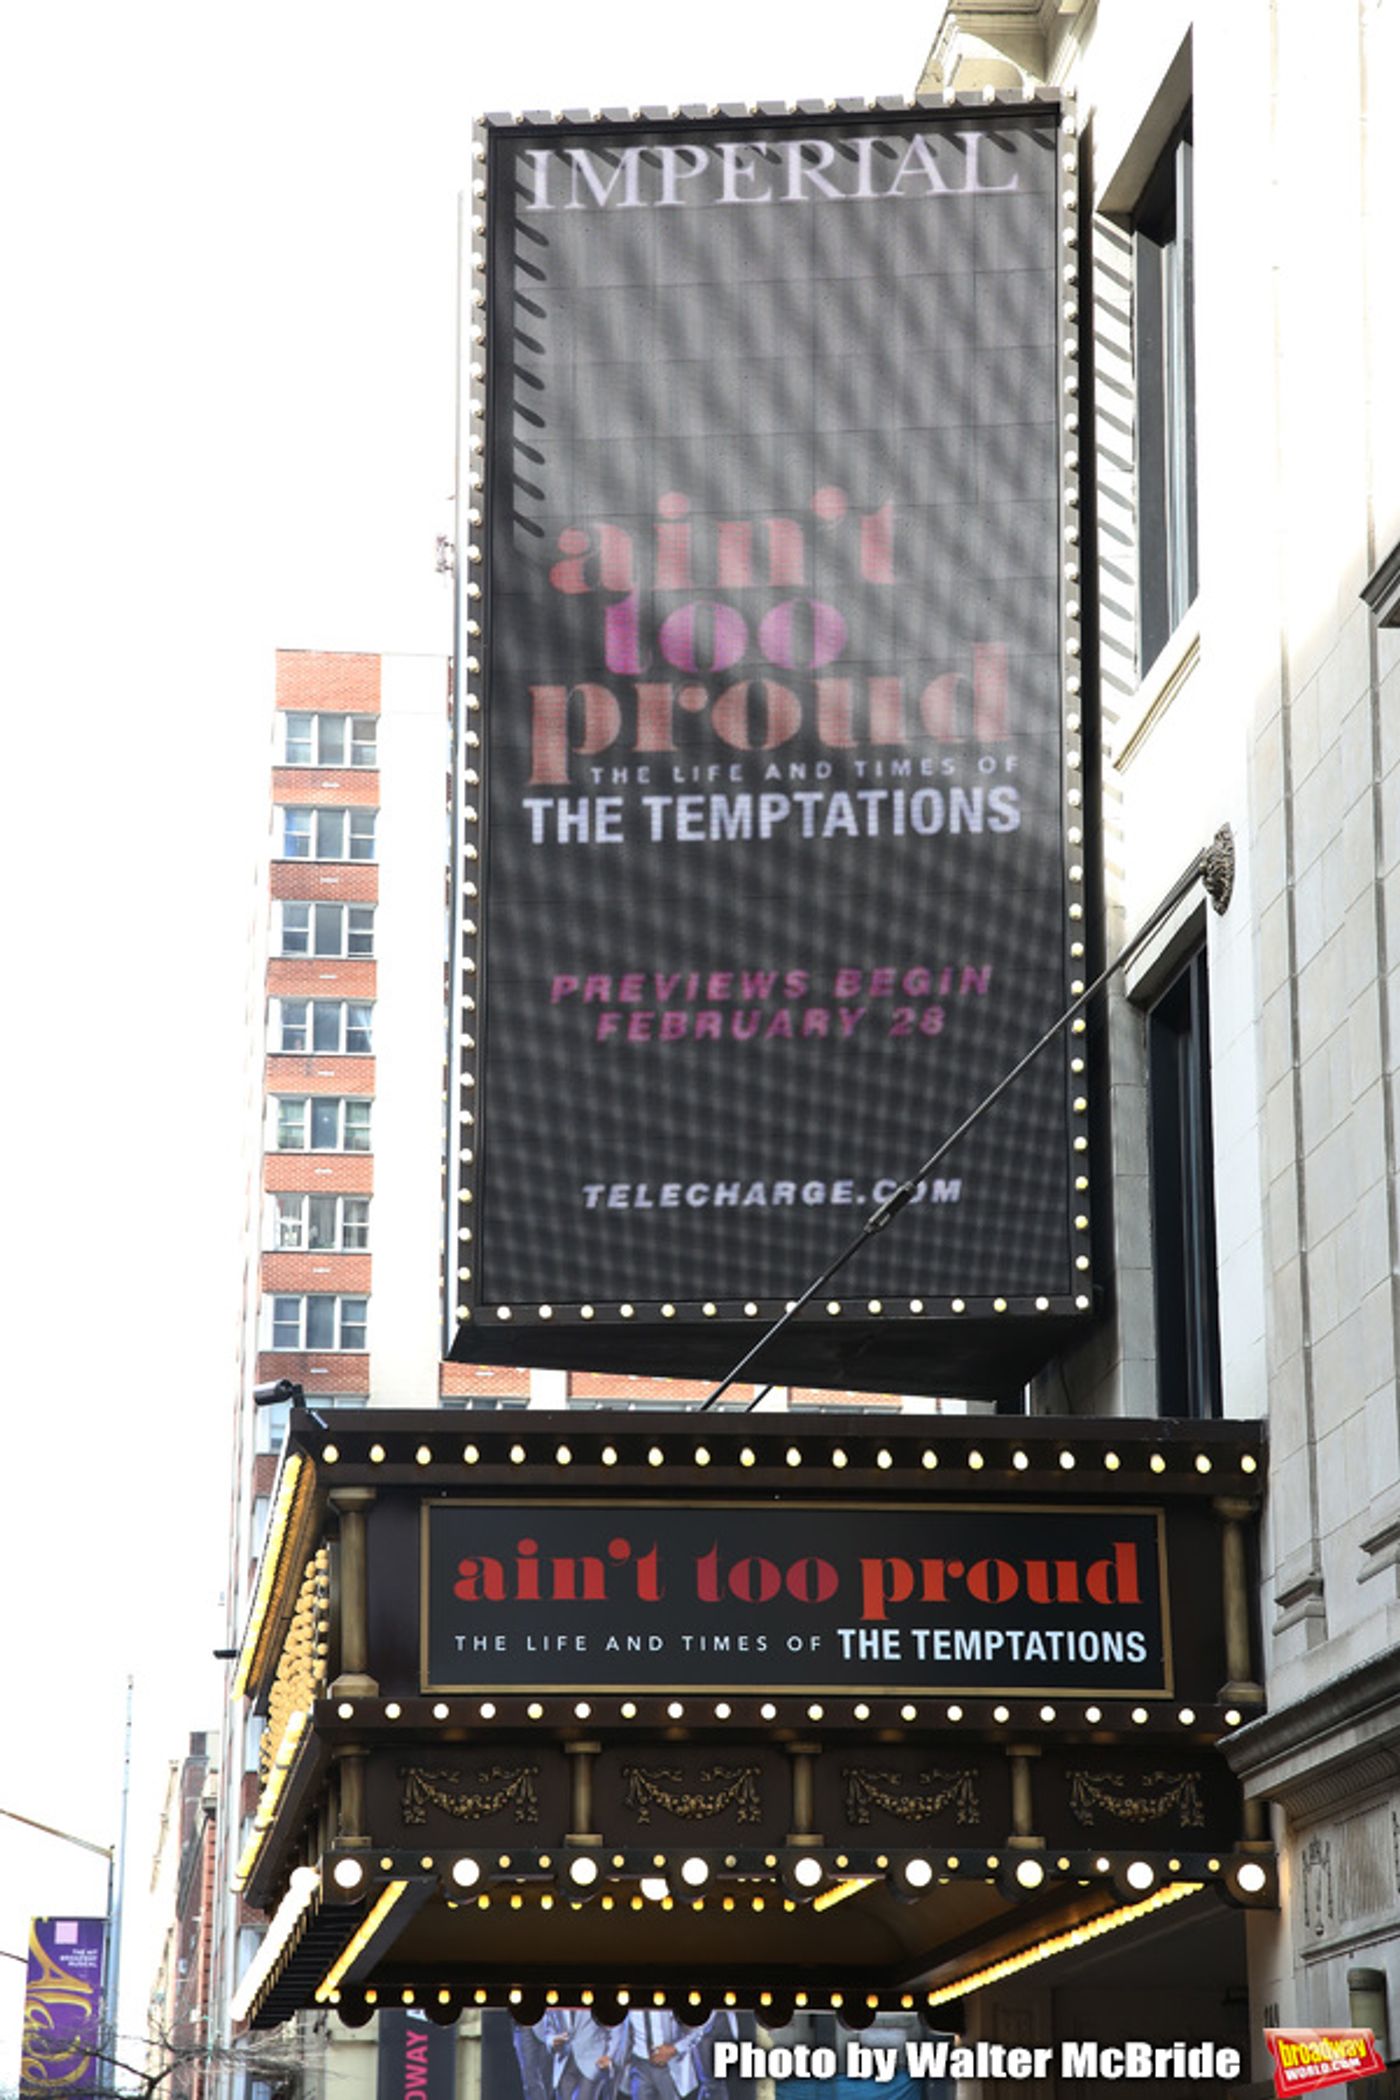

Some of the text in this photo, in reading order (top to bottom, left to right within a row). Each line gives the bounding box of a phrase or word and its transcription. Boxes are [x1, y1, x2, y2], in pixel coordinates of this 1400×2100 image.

[525, 131, 1019, 210] IMPERIAL
[550, 486, 896, 594] ain't
[604, 589, 848, 675] too
[528, 642, 1011, 785] proud
[590, 754, 1020, 785] THE LIFE AND TIMES OF
[522, 786, 1022, 844] THE TEMPTATIONS
[551, 965, 994, 1004] PREVIEWS BEGIN
[596, 1005, 946, 1042] FEBRUARY 28
[453, 1538, 1143, 1620] ain't too proud
[455, 1628, 1147, 1663] THE LIFE AND TIMES OF THE TEMPTATIONS
